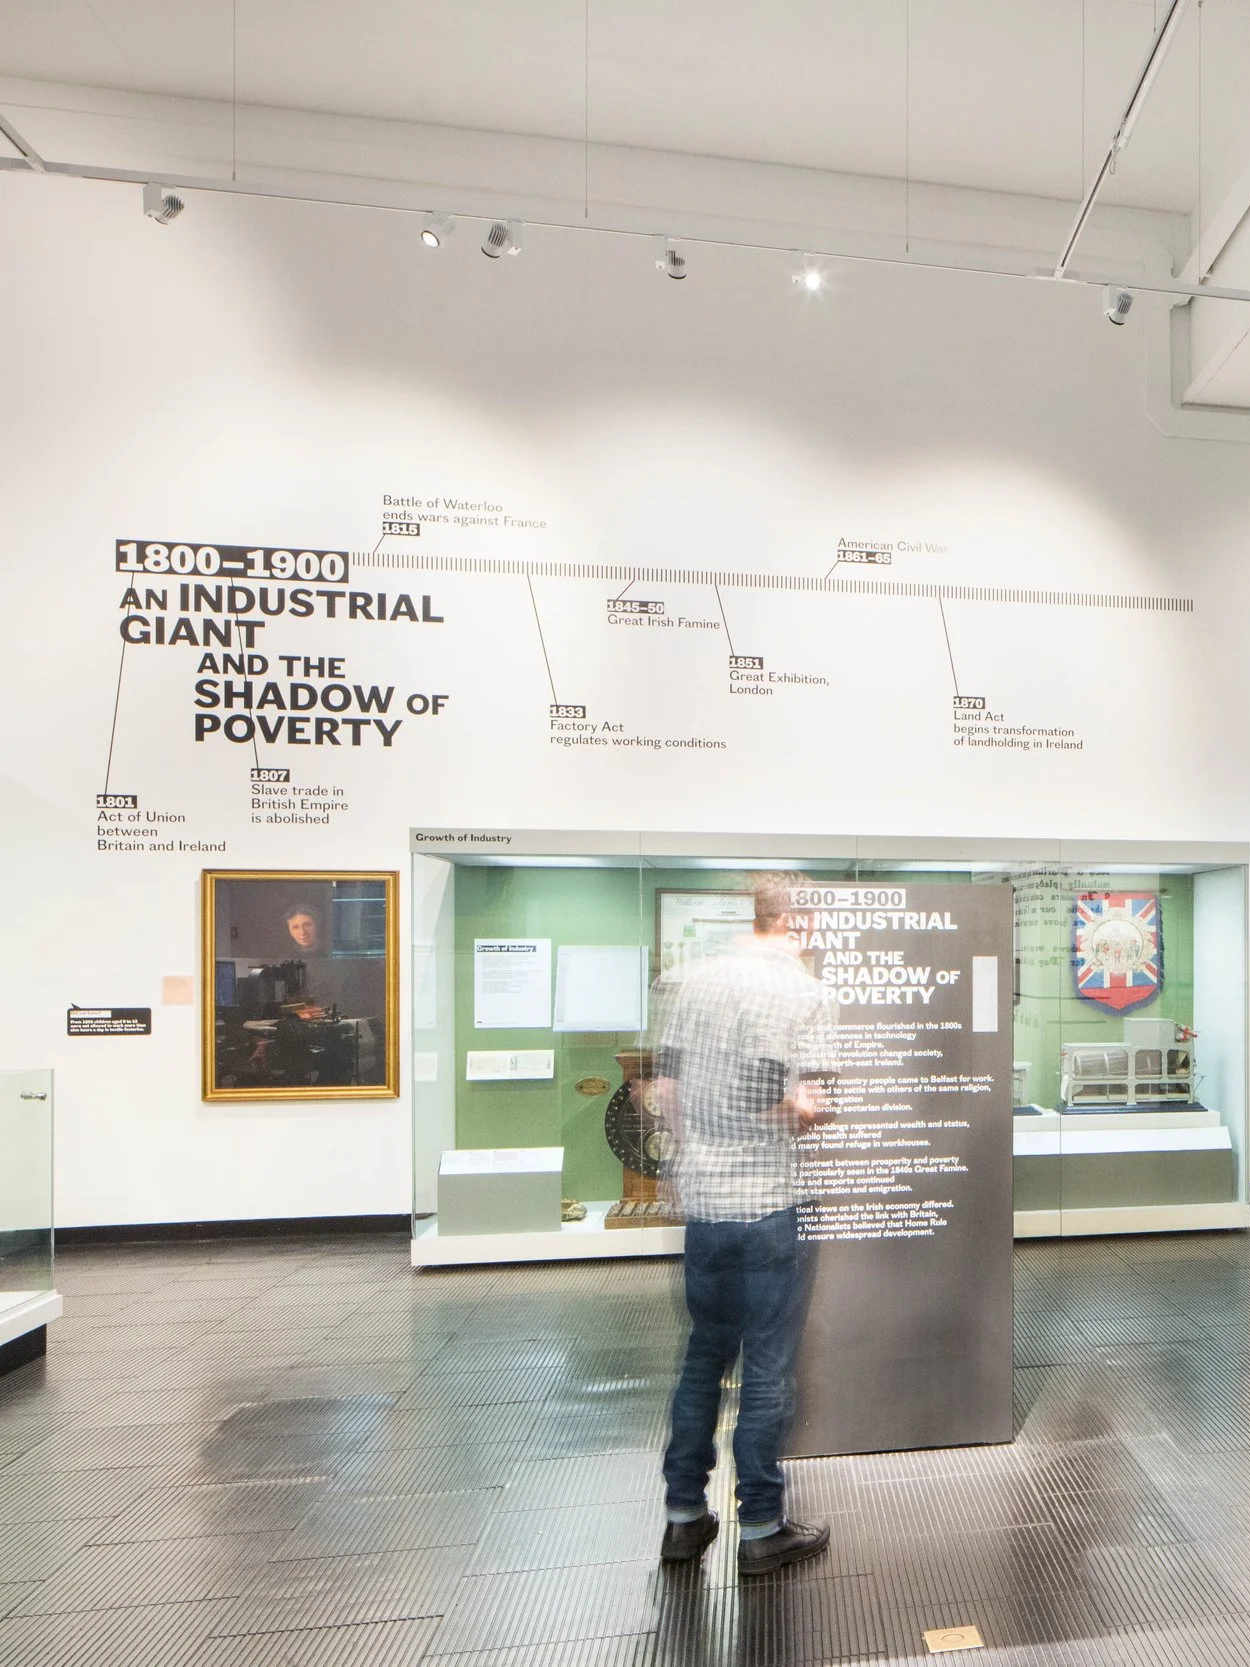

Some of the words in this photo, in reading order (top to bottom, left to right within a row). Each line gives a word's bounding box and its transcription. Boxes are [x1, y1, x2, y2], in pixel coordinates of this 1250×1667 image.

[383, 495, 422, 508] Battle
[427, 497, 439, 508] of
[443, 499, 503, 512] Waterloo
[383, 509, 413, 521] ends
[417, 513, 449, 524] wars
[453, 512, 500, 528] against
[504, 517, 547, 528] France
[383, 523, 418, 535] 1815
[838, 538, 893, 551] American
[897, 541, 922, 553] Civil
[925, 543, 947, 554] War
[119, 542, 345, 580] 1800–1900
[838, 550, 891, 564] 1861–65
[119, 588, 167, 610] AN
[180, 584, 444, 622] INDUSTRIAL
[607, 600, 664, 614] 1845–50
[607, 615, 644, 626] Great
[648, 616, 674, 627] Irish
[678, 618, 720, 630] Famine
[120, 615, 265, 648] GIANT
[197, 654, 269, 675] AND
[279, 656, 346, 678] THE
[729, 657, 760, 669] 1851
[729, 670, 764, 682] Great
[768, 672, 830, 686] Exhibition,
[730, 684, 773, 696] London
[194, 680, 395, 713] SHADOW
[406, 694, 449, 715] OF
[954, 697, 984, 709] 1870
[550, 706, 584, 718] 1833
[954, 710, 981, 721] Land
[984, 712, 1004, 722] Act
[195, 713, 403, 747] POVERTY
[550, 720, 597, 734] Factory
[602, 722, 624, 732] Act
[954, 724, 989, 736] begins
[993, 725, 1074, 737] transformation
[550, 736, 608, 747] regulates
[612, 736, 661, 750] working
[665, 738, 726, 749] conditions
[954, 736, 964, 747] of
[968, 737, 1030, 750] landholding
[1033, 738, 1043, 748] in
[1046, 738, 1083, 750] Ireland
[251, 770, 287, 781] 1807
[251, 784, 287, 796] Slave
[291, 785, 328, 796] trade
[332, 786, 344, 797] in
[97, 796, 135, 807] 1801
[251, 798, 297, 810] British
[300, 799, 349, 813] Empire
[97, 811, 126, 822] Act
[129, 811, 142, 823] of
[146, 812, 186, 823] Union
[251, 812, 262, 824] is
[265, 813, 330, 825] abolished
[97, 825, 158, 837] between
[97, 840, 145, 851] Britain
[149, 840, 174, 852] and
[178, 841, 226, 852] Ireland
[416, 833, 454, 844] Growth
[457, 833, 468, 843] of
[470, 834, 512, 845] Industry
[791, 890, 902, 907] 800–1900
[814, 912, 958, 930] INDUSTRIAL
[823, 952, 862, 965] AND
[867, 952, 904, 965] THE
[821, 967, 930, 985] SHADOW
[936, 971, 960, 984] OF
[823, 986, 935, 1004] POVERTY
[837, 1078, 868, 1086] country
[870, 1076, 895, 1085] people
[930, 1075, 957, 1083] Belfast
